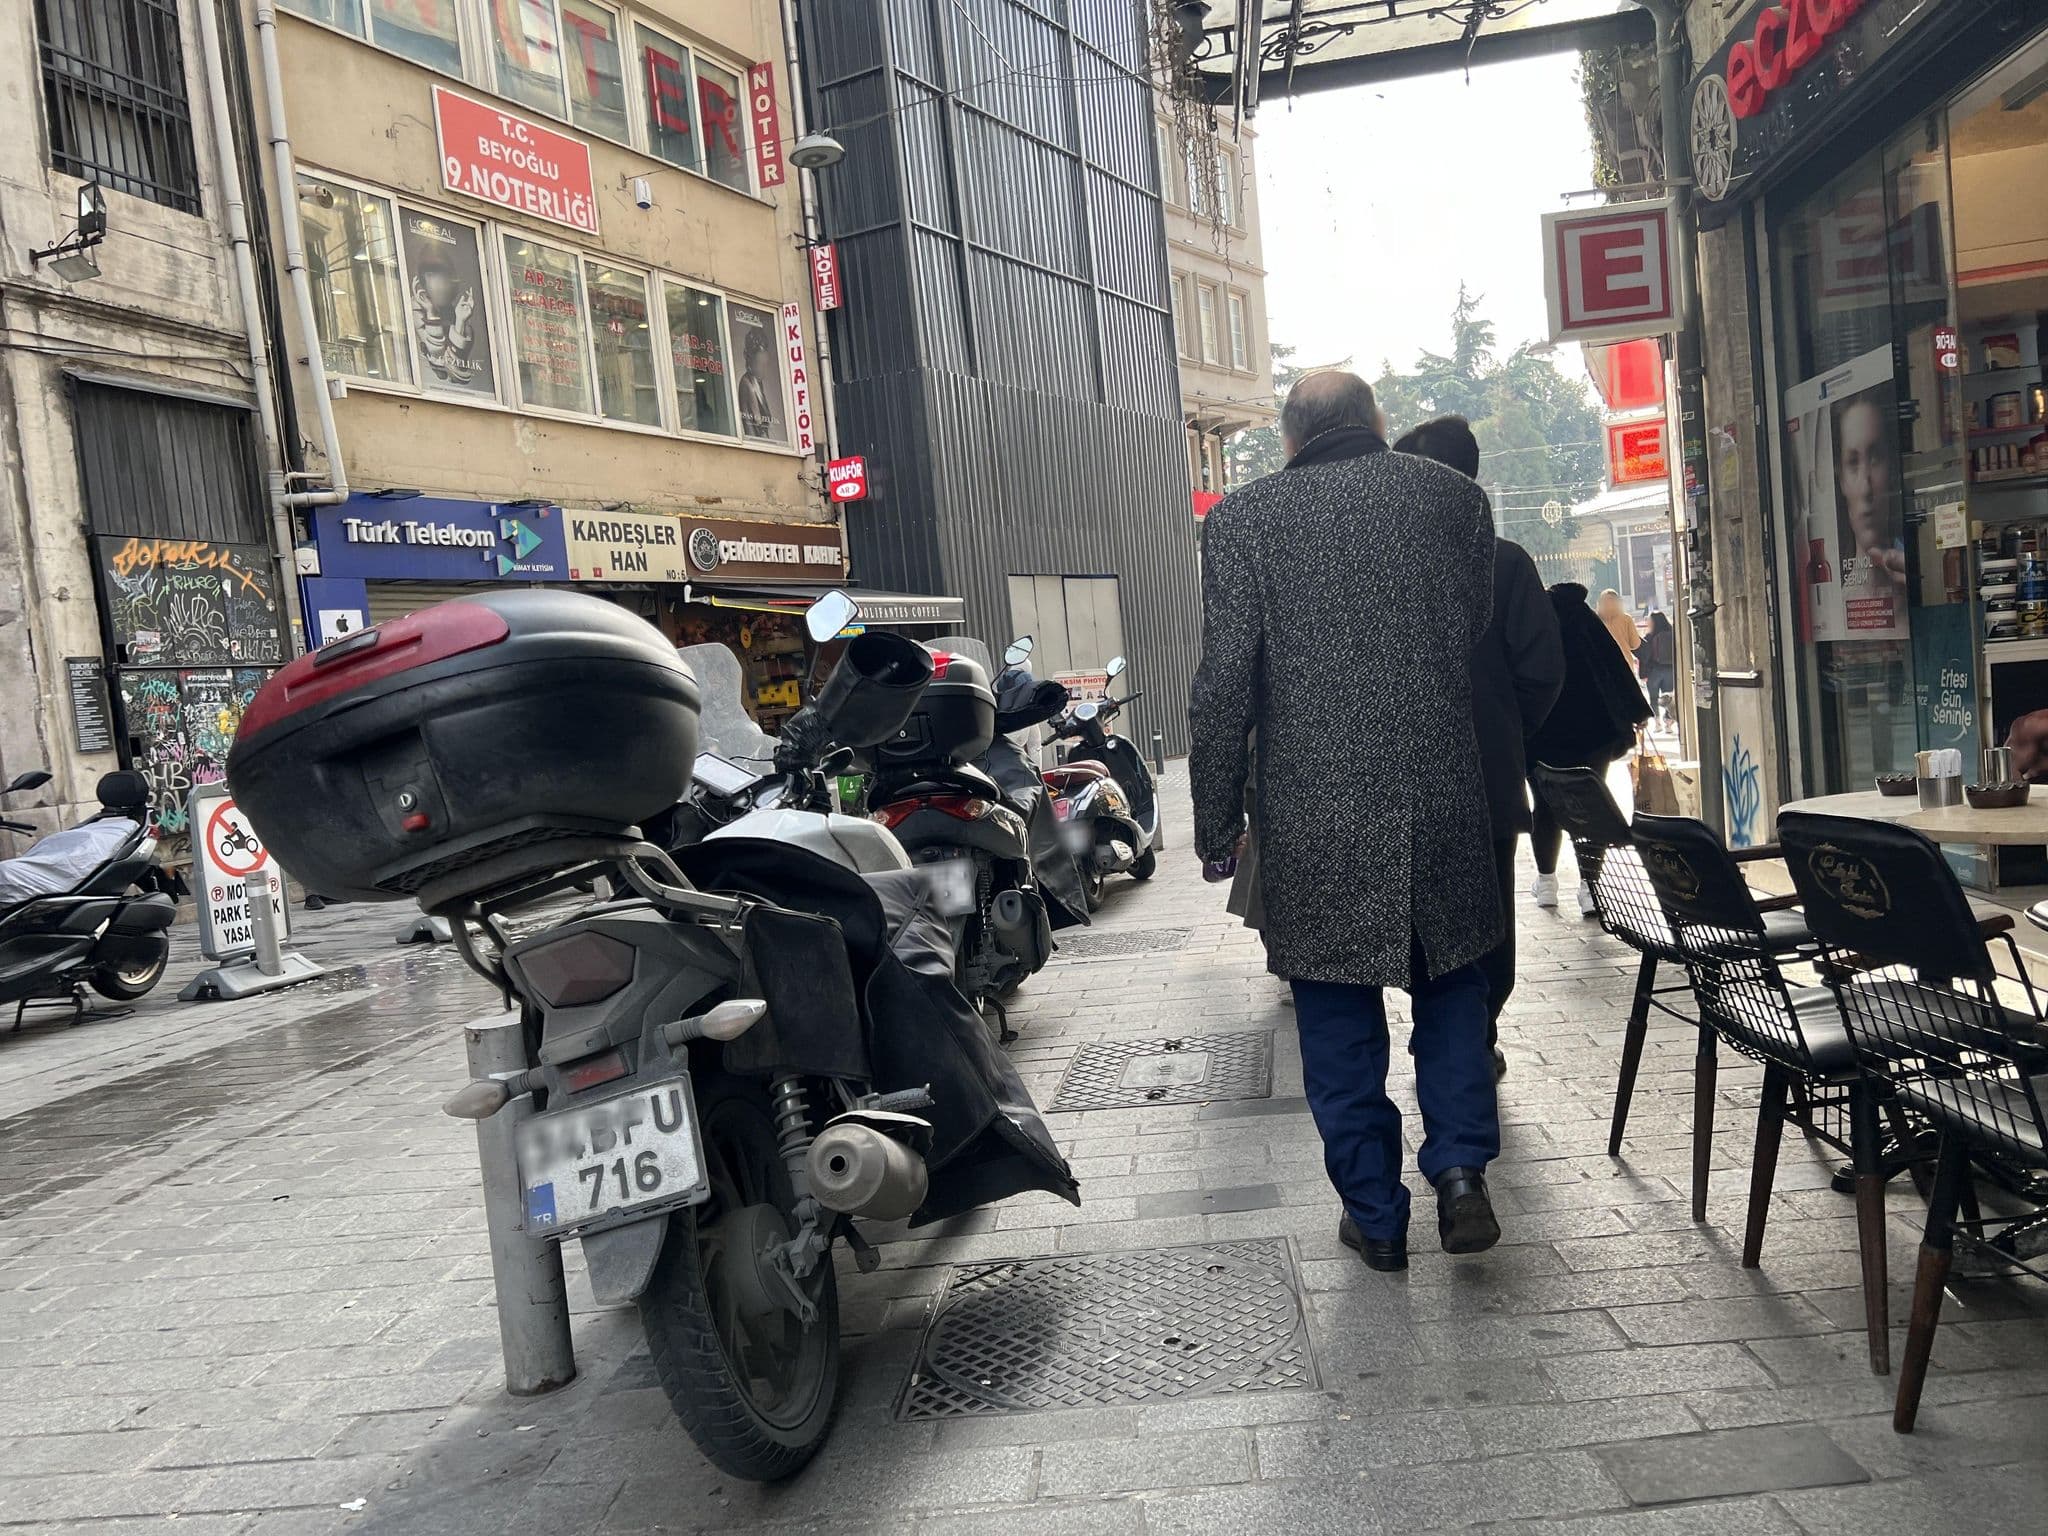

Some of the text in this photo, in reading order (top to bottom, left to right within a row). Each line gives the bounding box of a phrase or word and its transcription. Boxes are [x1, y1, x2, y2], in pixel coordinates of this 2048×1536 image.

[498, 116, 535, 146] T.C.
[753, 71, 779, 182] NOTER
[478, 136, 559, 180] BEYOĞLU
[815, 246, 837, 310] NOTER
[1580, 228, 1650, 312] E
[785, 306, 798, 317] AR
[788, 325, 812, 449] KUAFÖR
[829, 461, 863, 482] KUAFÖR
[342, 518, 496, 548] Türk Telekom
[572, 520, 676, 549] KARDEŞLER
[610, 551, 648, 571] HAN
[719, 536, 800, 564] ÇEKİRDEKTEN
[803, 545, 842, 565] KAHVE
[912, 606, 941, 617] COFFEE
[1941, 668, 1968, 688] Ertesi
[1941, 690, 1961, 708] Gün
[1933, 704, 1972, 727] Seninle
[227, 883, 248, 901] MOT
[214, 905, 242, 925] PARK
[224, 925, 254, 945] YASA
[579, 1151, 662, 1210] 716
[533, 1213, 552, 1225] TR
